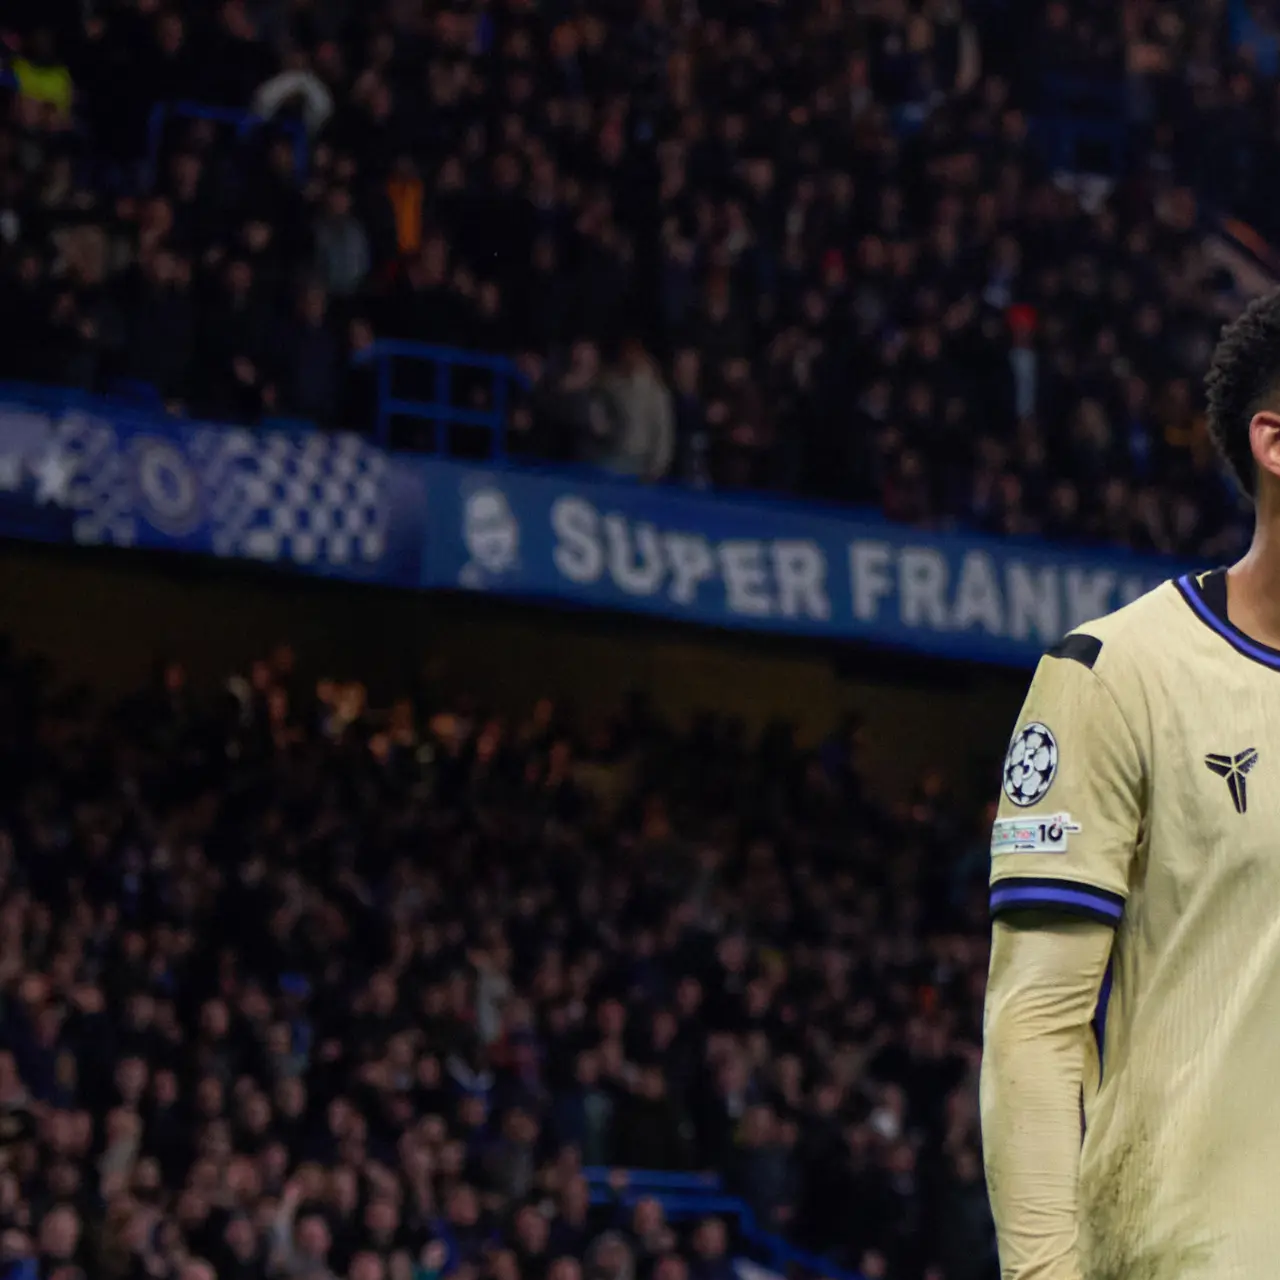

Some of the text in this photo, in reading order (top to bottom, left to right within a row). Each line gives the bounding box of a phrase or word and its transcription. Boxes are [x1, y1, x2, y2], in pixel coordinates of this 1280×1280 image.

[552, 496, 1144, 648] SUPER FRANK
[1039, 824, 1063, 842] 10
